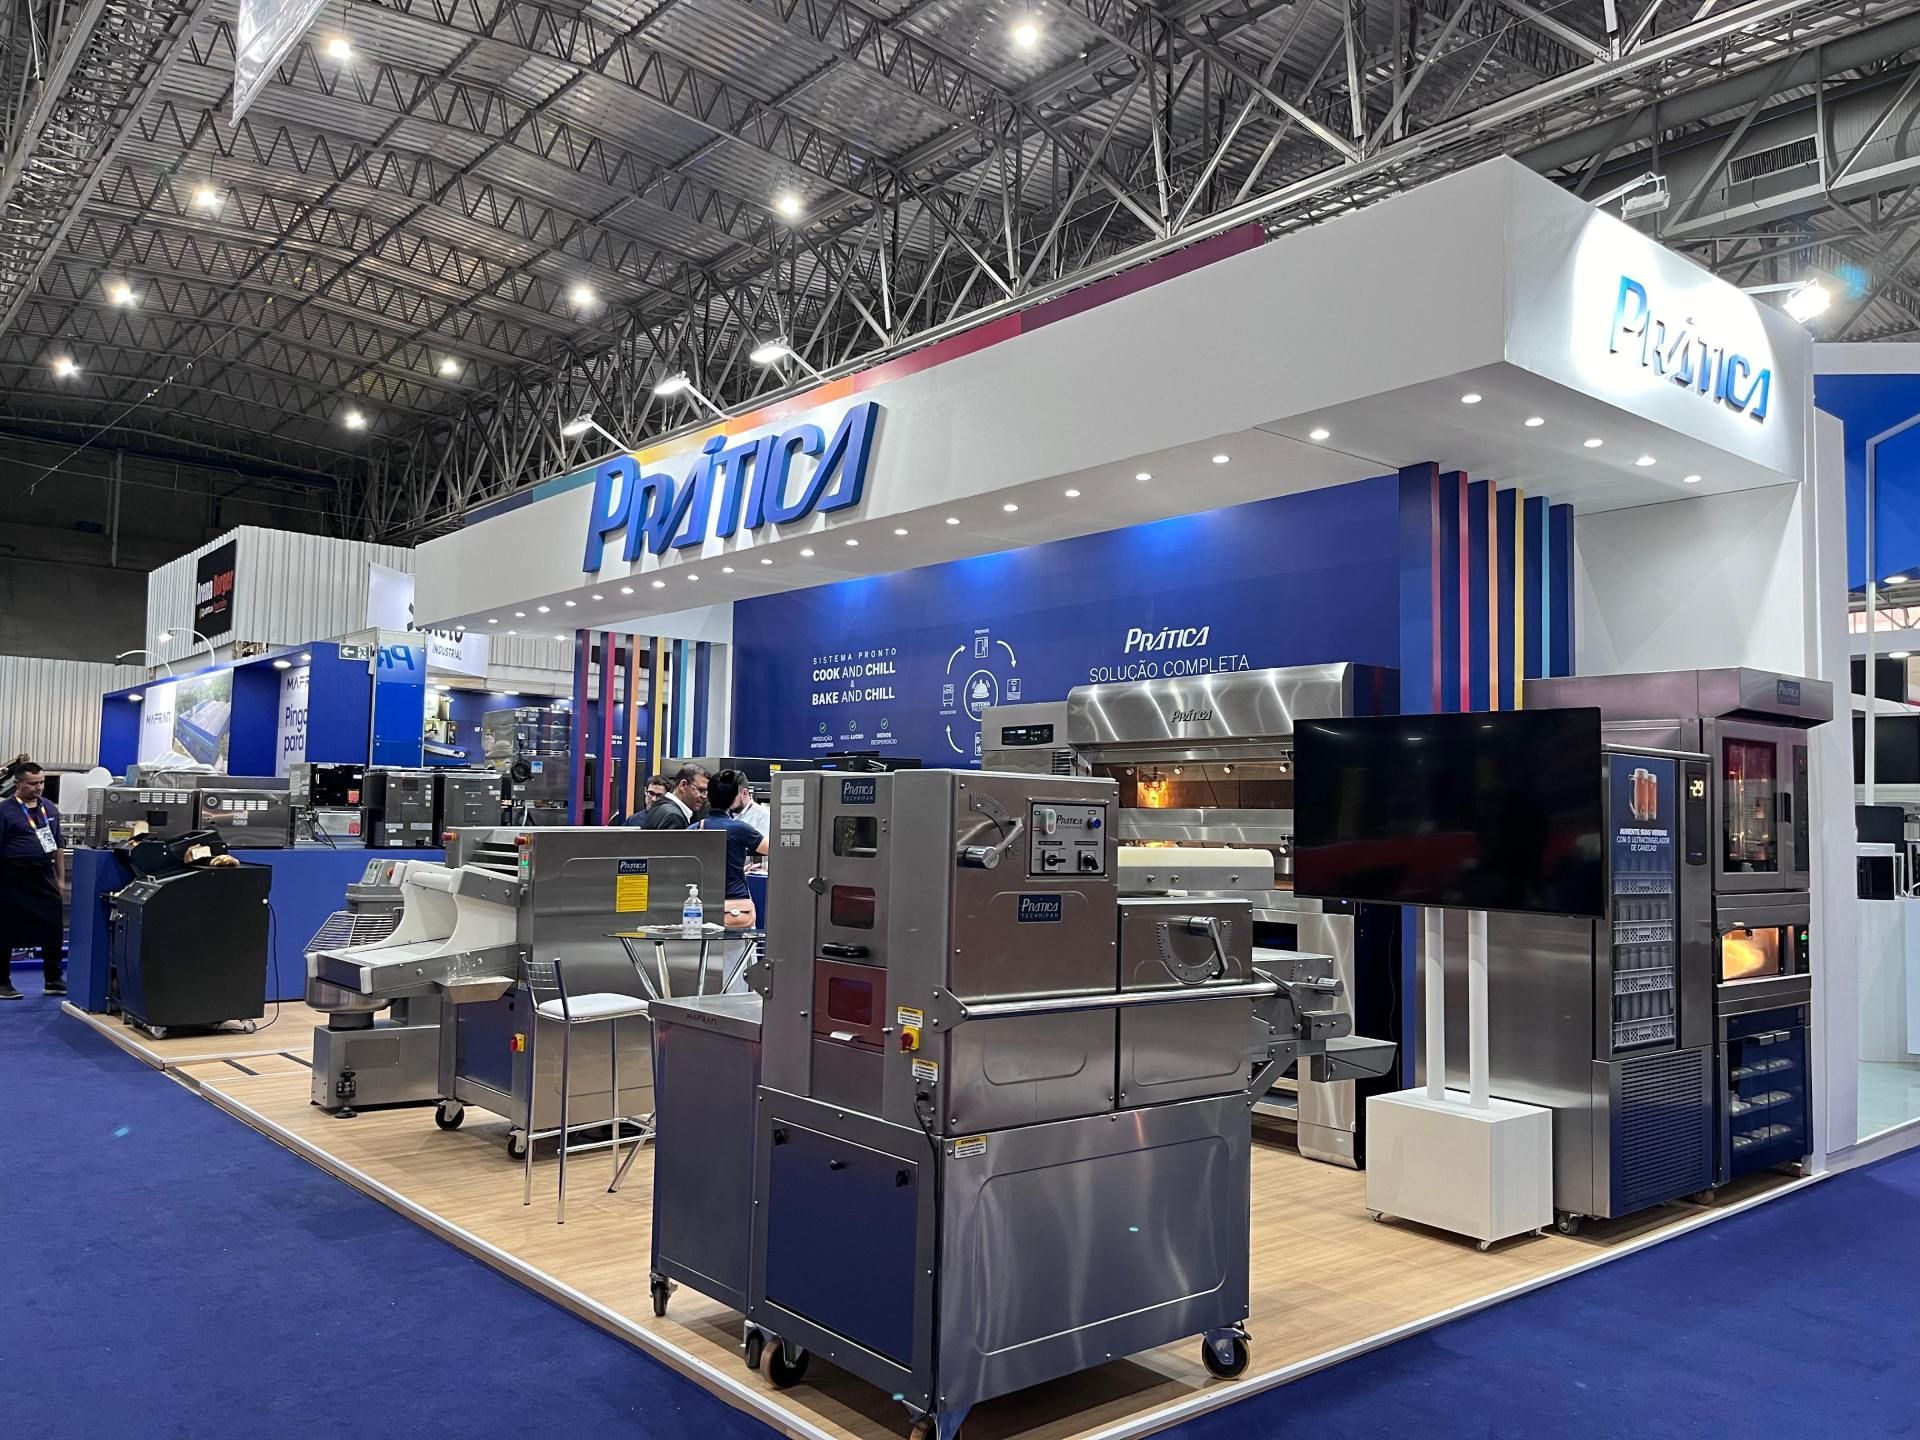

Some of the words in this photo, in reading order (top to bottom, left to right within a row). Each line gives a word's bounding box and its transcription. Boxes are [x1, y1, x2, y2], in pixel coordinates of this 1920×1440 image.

[1610, 275, 1772, 424] PRÁTICA
[583, 401, 879, 573] PRÁTICA
[1124, 626, 1210, 653] PRÁTICA
[813, 653, 852, 665] SISTEMA
[858, 647, 897, 660] PRONTO
[1089, 660, 1158, 683] SOLUÇÃO
[1163, 654, 1250, 677] COMPLETA
[813, 667, 840, 682] COOK
[842, 665, 863, 678] AND
[865, 661, 896, 676] CHILL
[812, 692, 839, 705] BAKE
[841, 690, 862, 703] AND
[864, 687, 895, 701] CHILL
[1171, 709, 1213, 722] PRÁTICA
[284, 734, 304, 760] para
